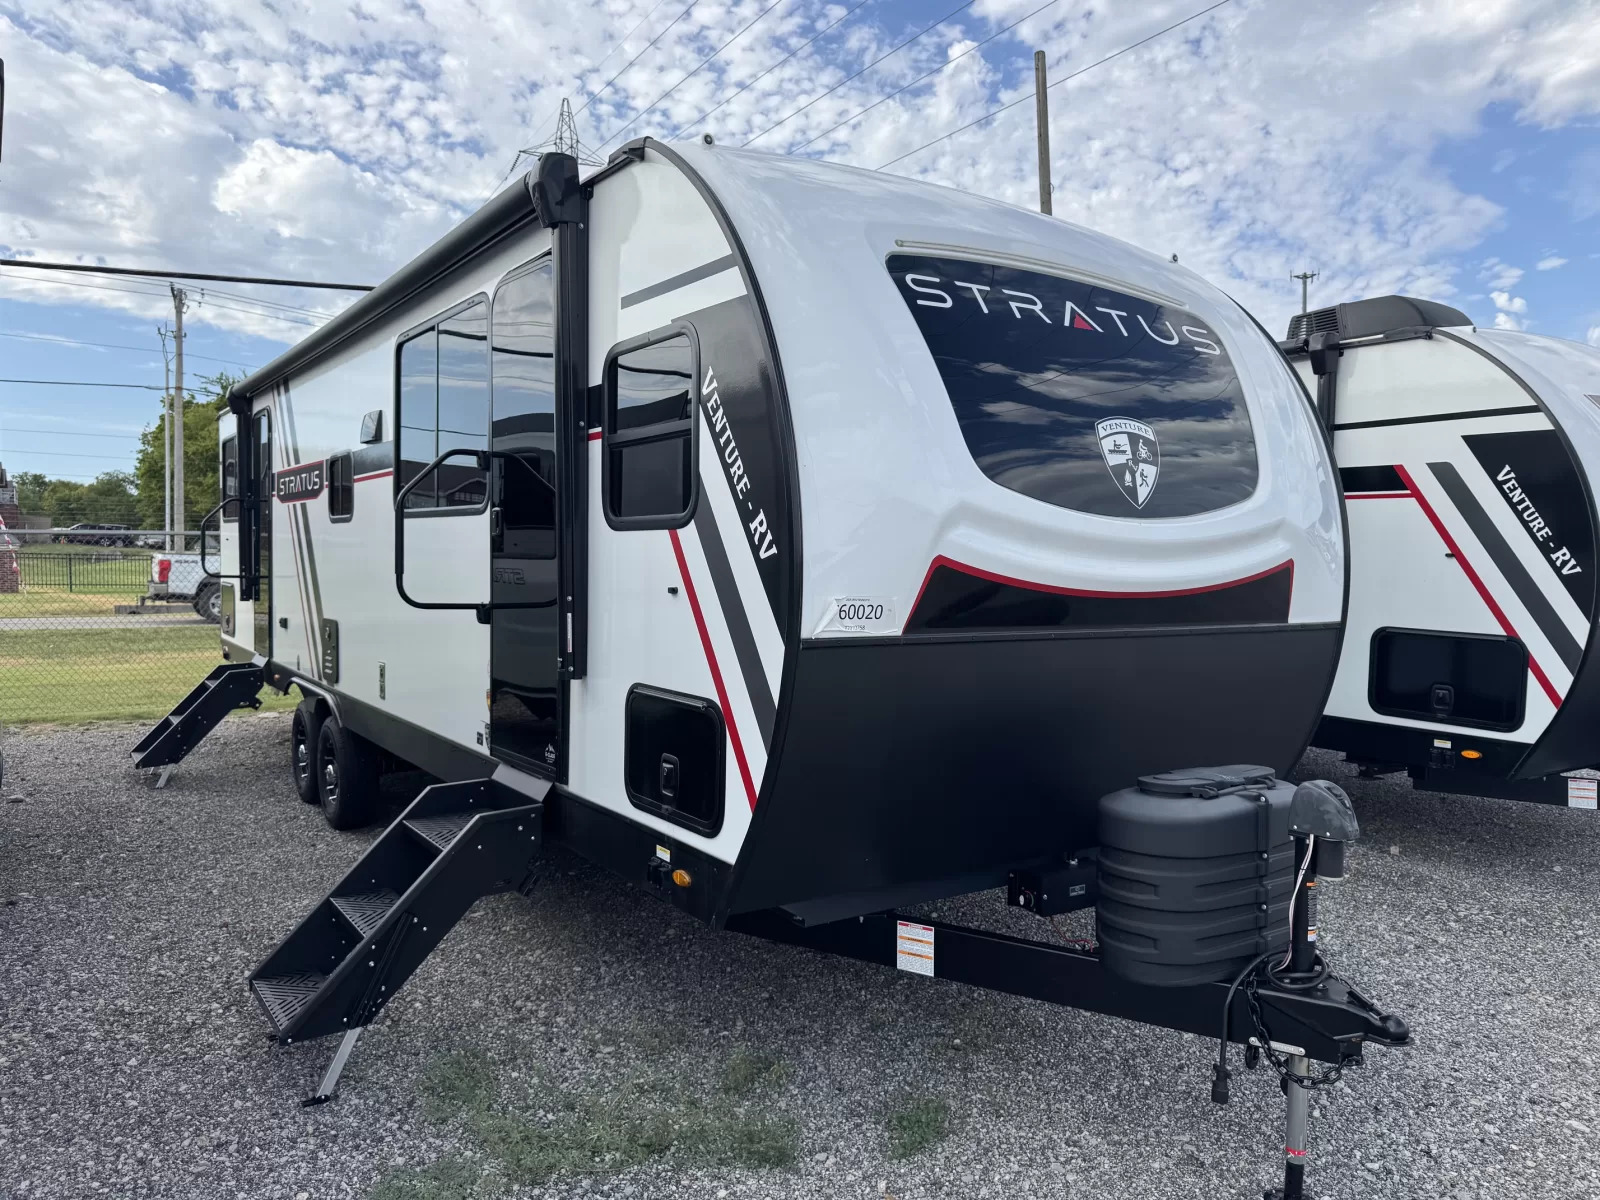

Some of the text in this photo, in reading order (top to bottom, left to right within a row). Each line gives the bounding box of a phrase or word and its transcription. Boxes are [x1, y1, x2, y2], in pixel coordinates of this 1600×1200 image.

[905, 273, 1221, 355] STRATUS
[1101, 422, 1151, 437] VENTURE
[279, 470, 320, 495] STRATUS
[702, 366, 751, 499] VENTURE
[749, 509, 778, 560] RV
[1496, 464, 1553, 541] VENTURE
[1550, 546, 1582, 575] RV
[837, 604, 884, 620] 60020
